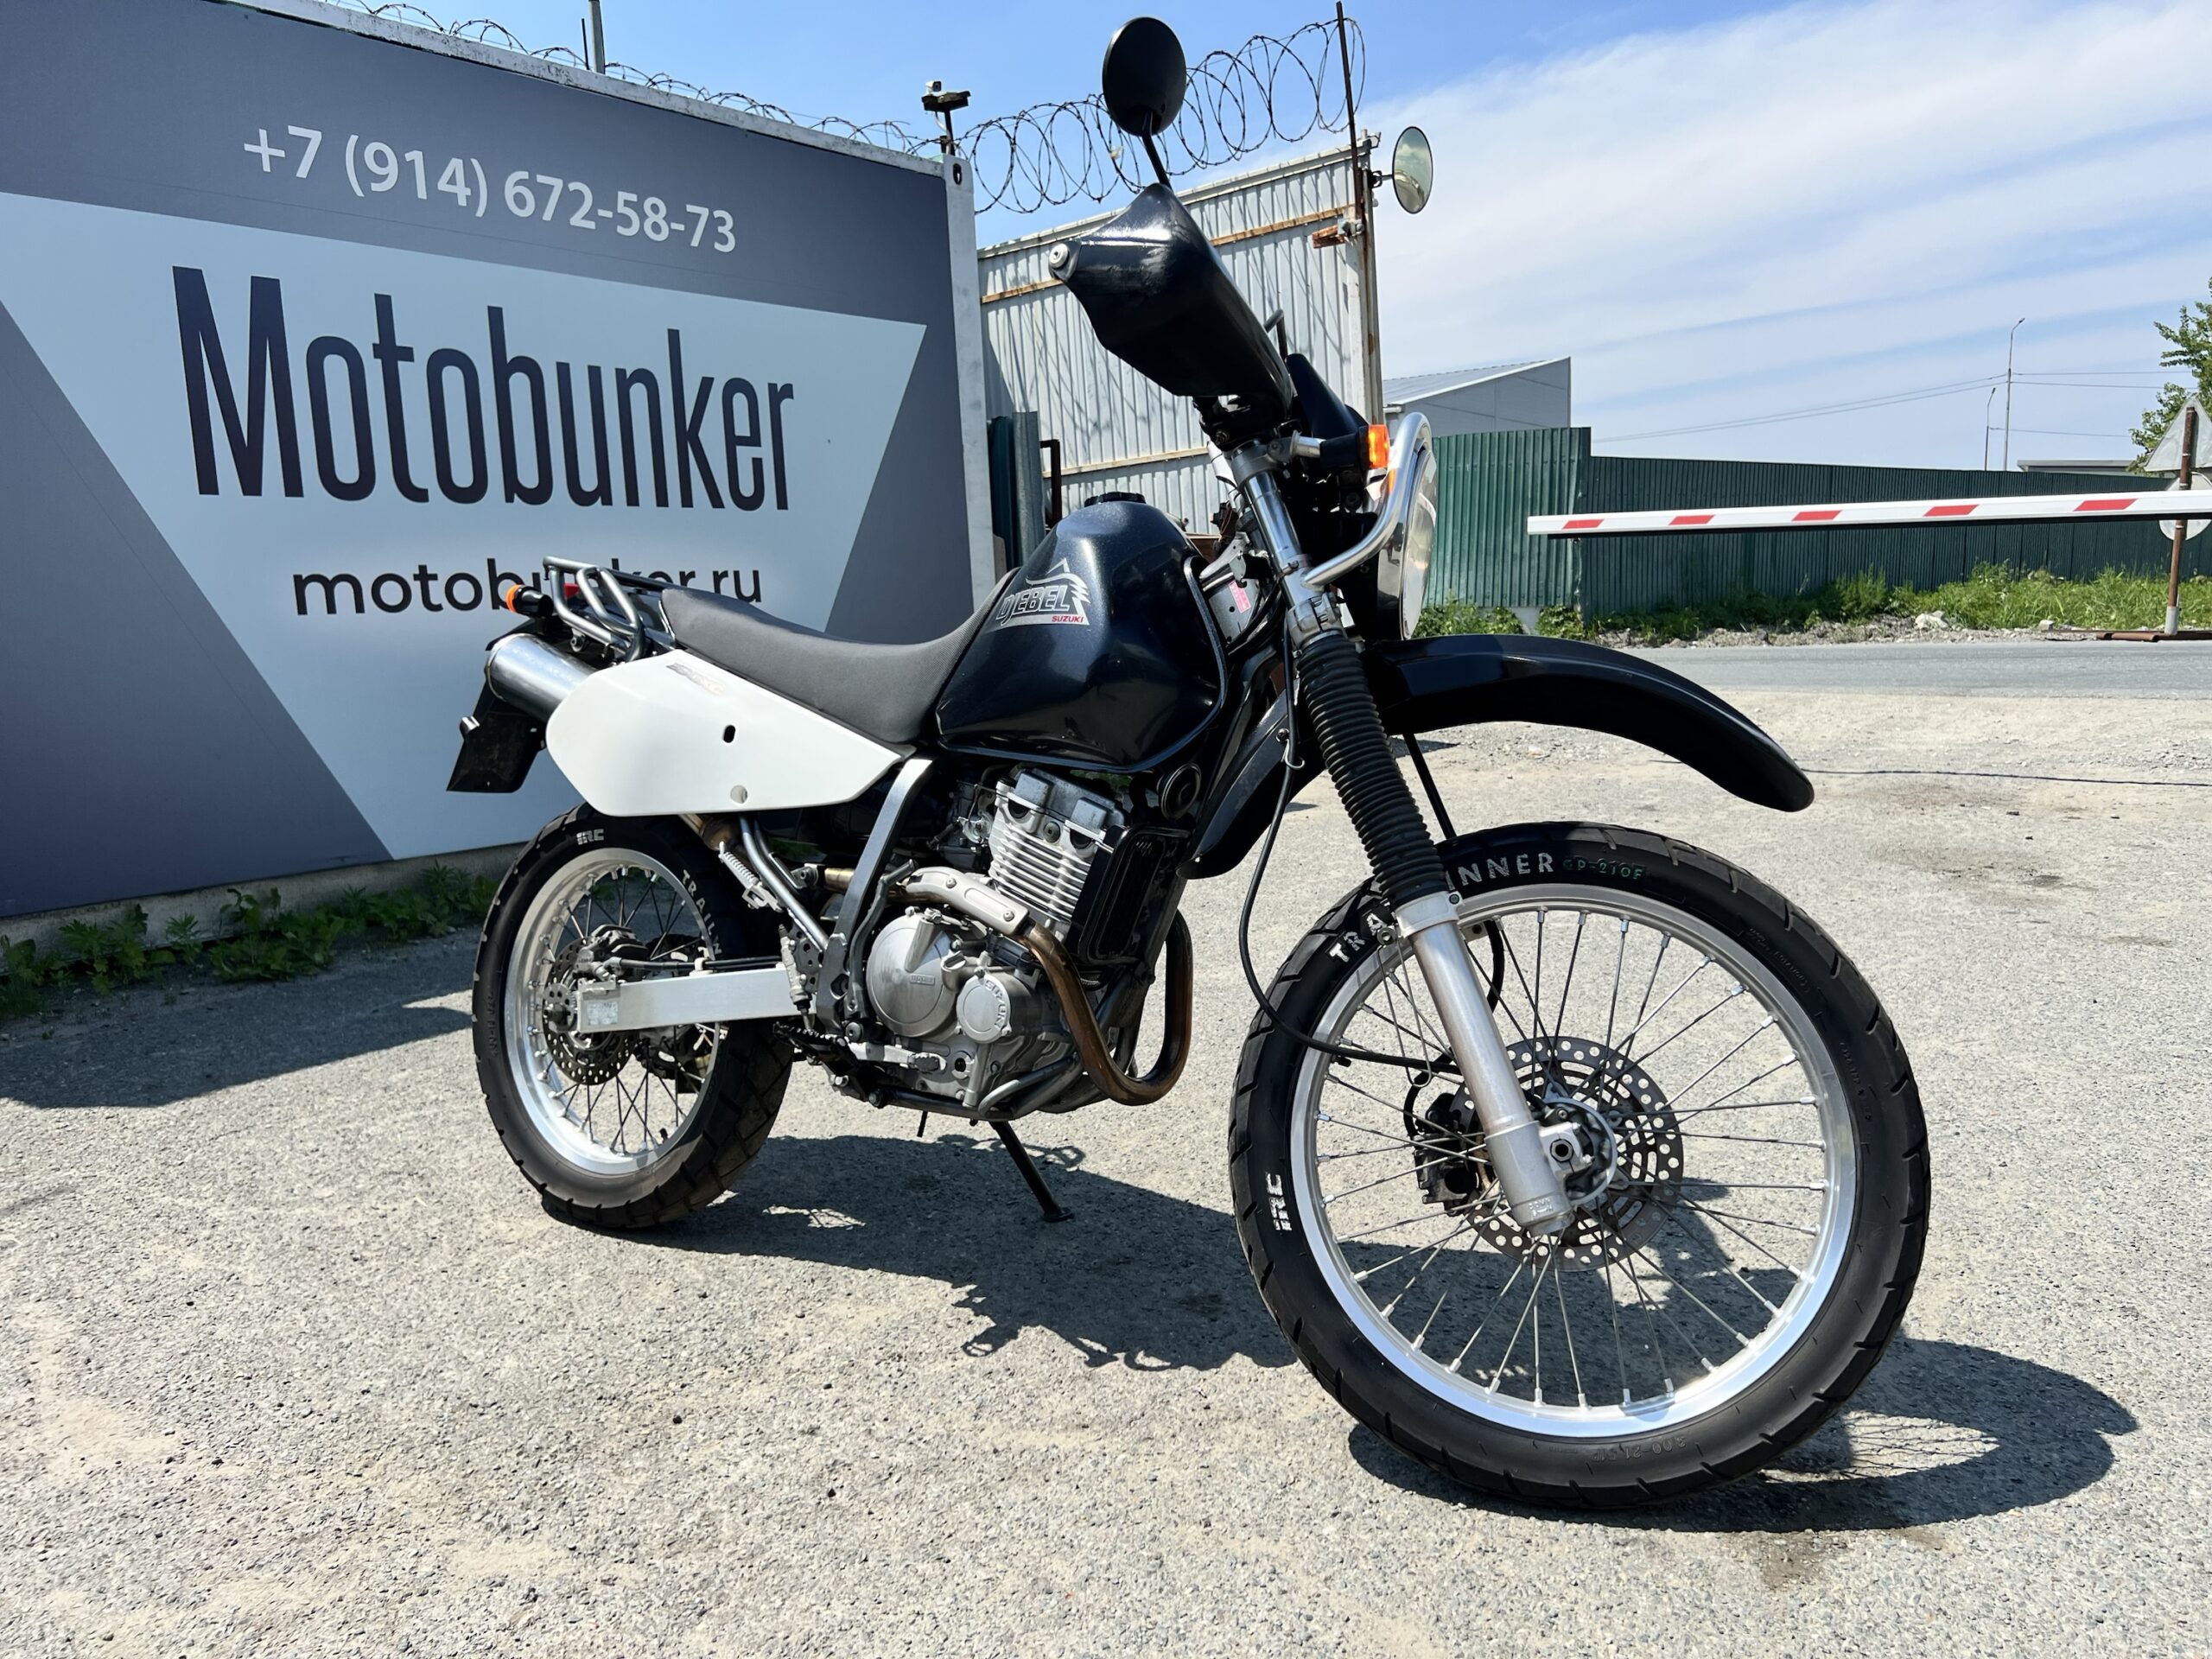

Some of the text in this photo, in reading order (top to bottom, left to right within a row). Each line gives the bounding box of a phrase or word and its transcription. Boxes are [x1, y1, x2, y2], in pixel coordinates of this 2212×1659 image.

[244, 125, 736, 253] +7 (914) 672-58-73
[172, 265, 794, 512] Motobunker
[1052, 614, 1084, 623] SUZUKI
[576, 828, 605, 846] IRC
[1445, 851, 1554, 892] INNER
[1264, 1171, 1293, 1231] IRC
